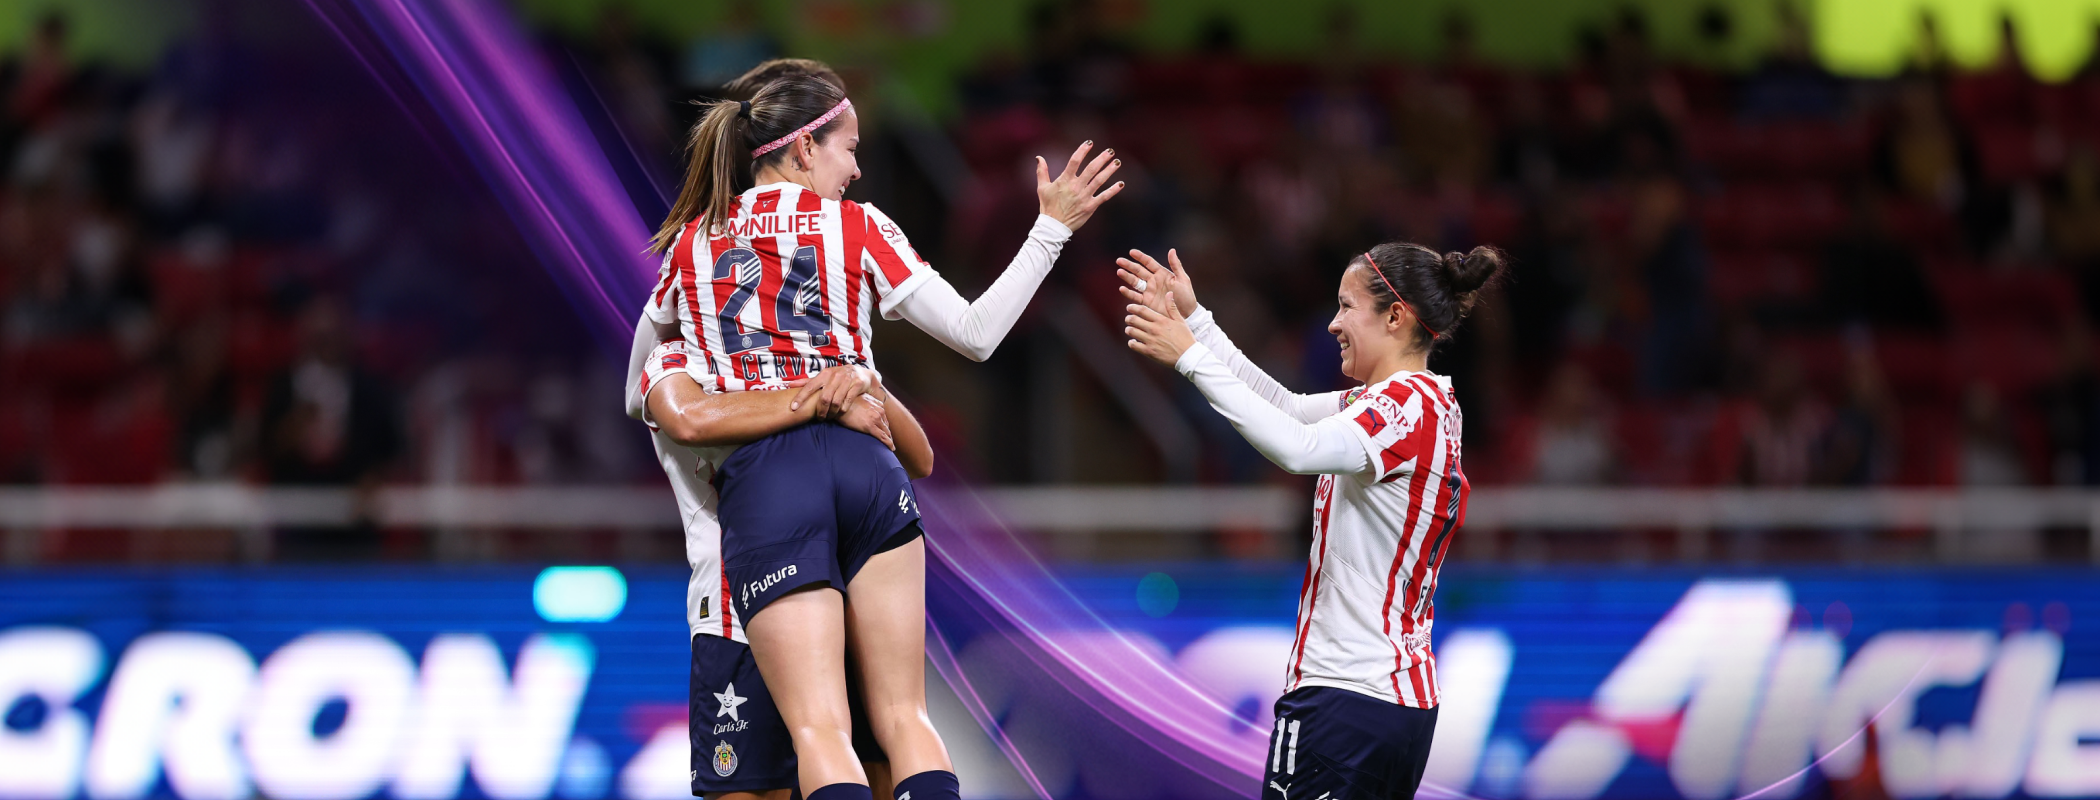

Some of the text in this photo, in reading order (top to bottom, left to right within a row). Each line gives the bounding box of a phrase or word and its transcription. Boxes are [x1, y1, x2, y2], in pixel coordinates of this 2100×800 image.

[712, 246, 832, 354] 24
[750, 564, 798, 598] Futura
[713, 721, 735, 735] Carl's
[1272, 717, 1301, 776] 11
